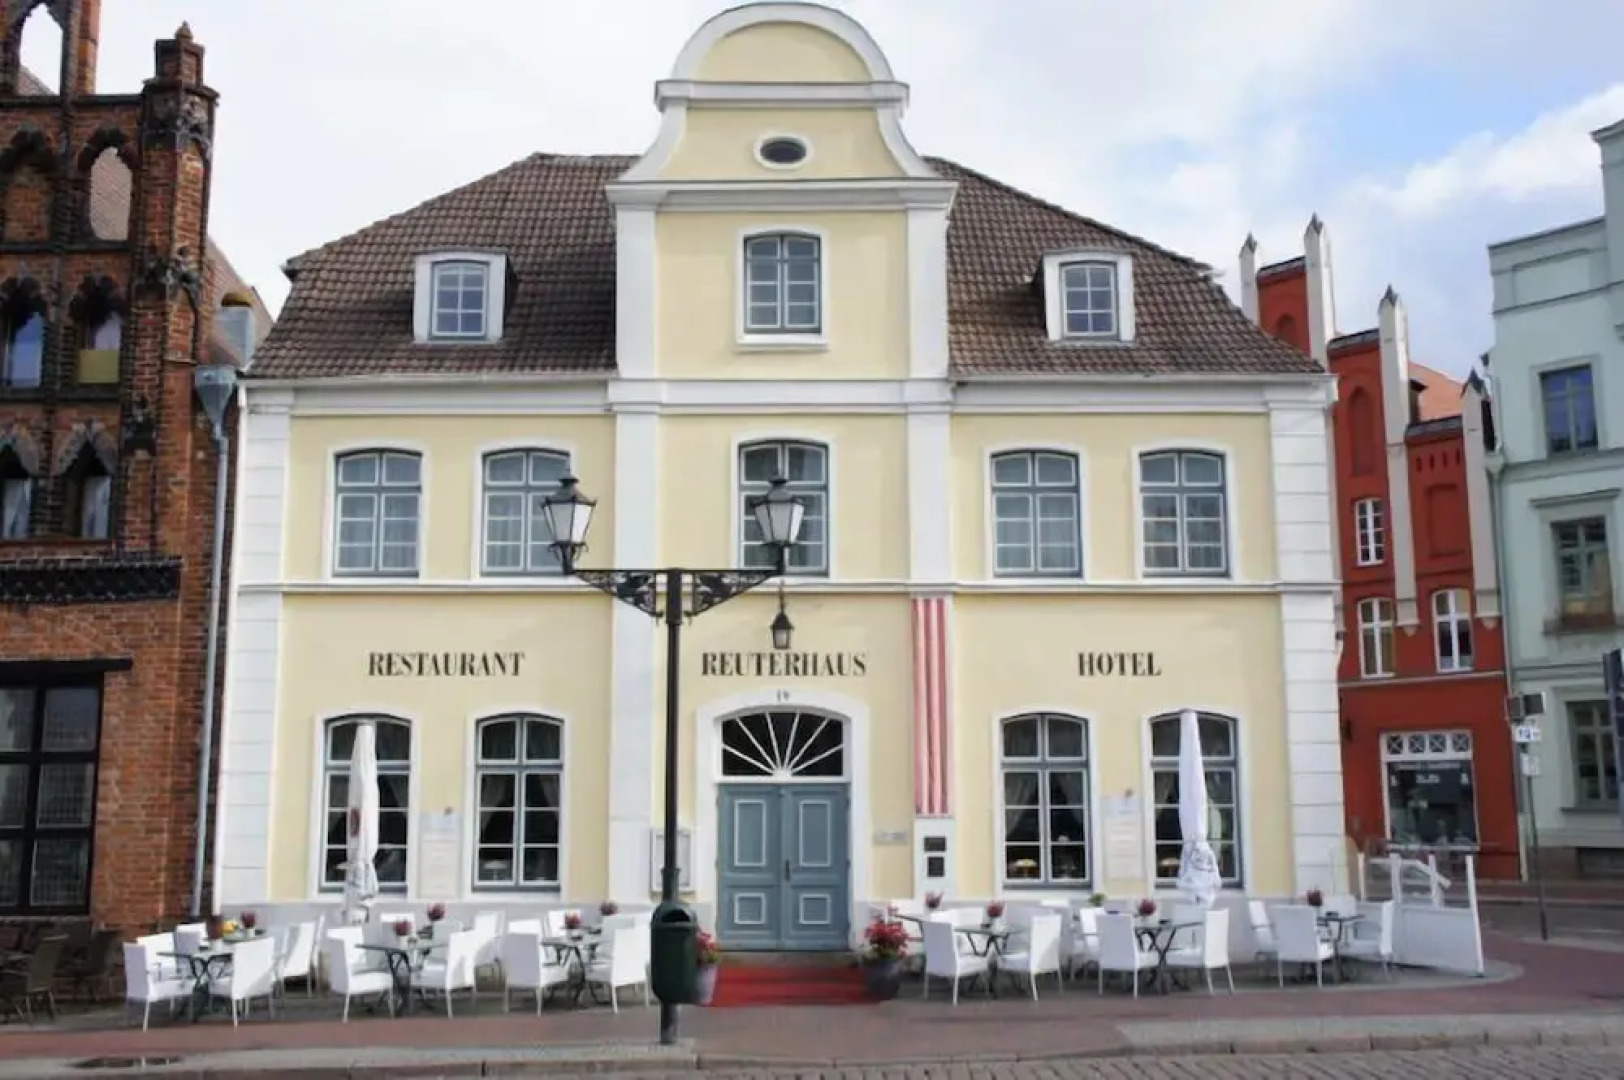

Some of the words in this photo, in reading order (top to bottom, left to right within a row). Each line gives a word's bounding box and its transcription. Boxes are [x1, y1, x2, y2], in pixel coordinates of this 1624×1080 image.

[368, 651, 527, 677] RESTAURANT
[701, 651, 867, 677] REUTERHAUS
[1077, 651, 1162, 677] HOTEL
